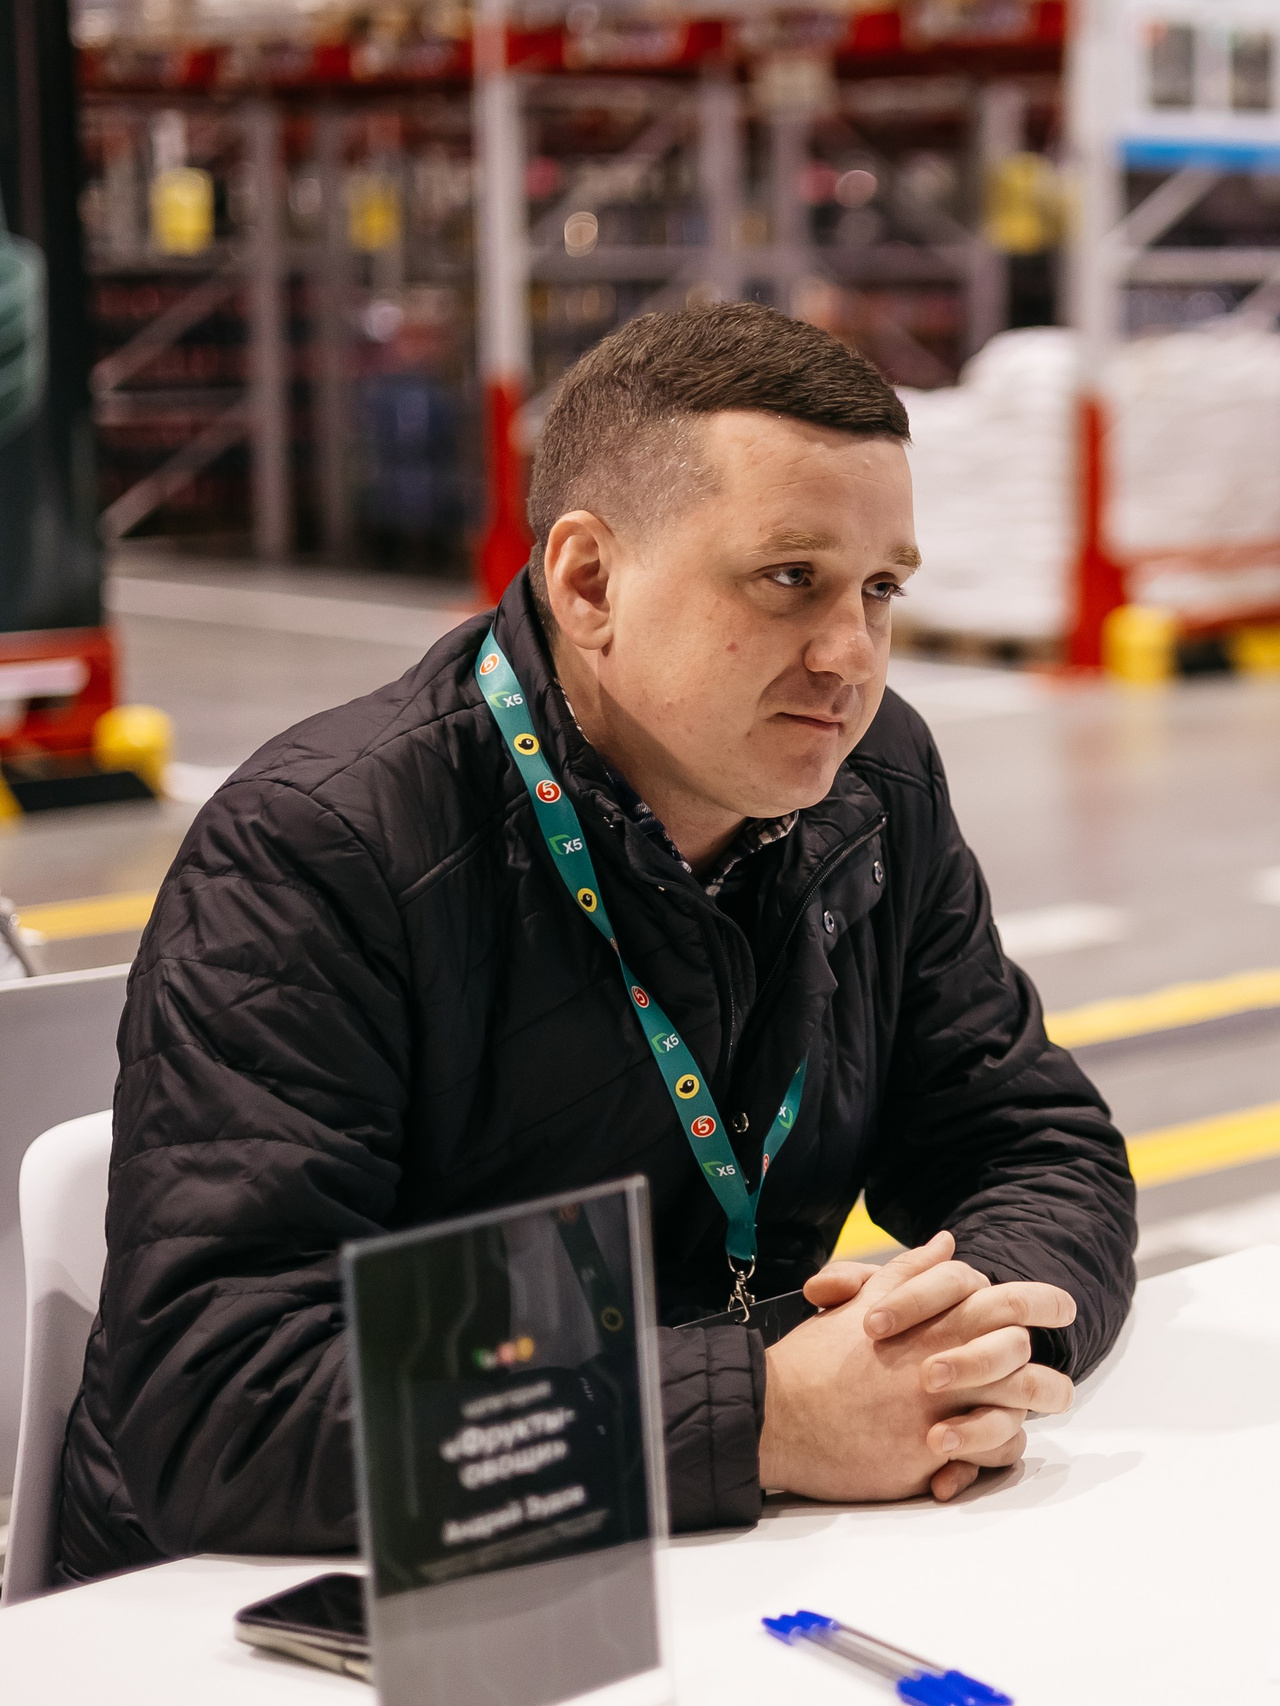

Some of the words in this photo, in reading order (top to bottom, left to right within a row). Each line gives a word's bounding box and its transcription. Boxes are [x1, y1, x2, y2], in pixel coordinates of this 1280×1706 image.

[503, 693, 524, 708] X5
[542, 781, 555, 799] 5
[562, 837, 583, 855] X5
[662, 1033, 680, 1052] X5
[716, 1164, 736, 1177] X5
